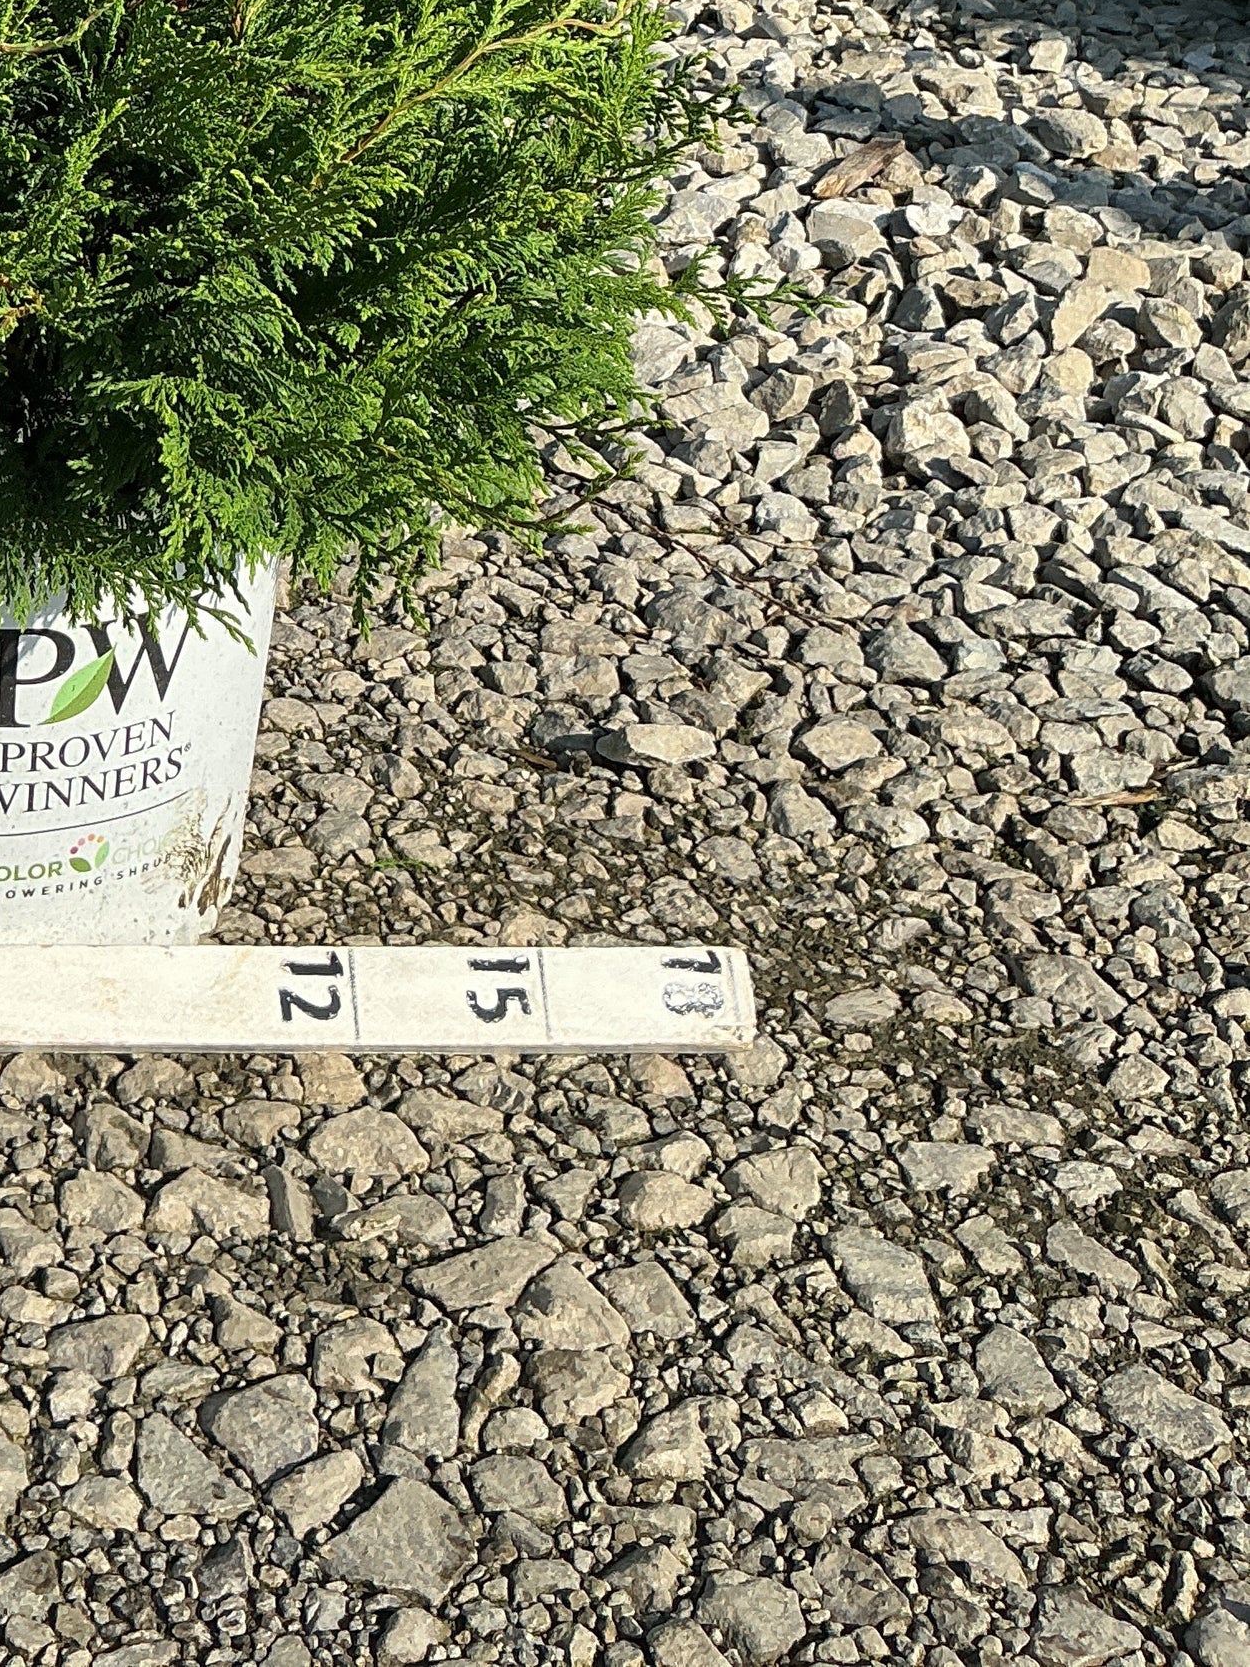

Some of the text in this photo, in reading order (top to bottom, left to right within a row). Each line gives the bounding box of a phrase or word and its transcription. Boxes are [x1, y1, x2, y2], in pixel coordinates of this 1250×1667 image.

[116, 850, 172, 880] SHRUB
[279, 951, 344, 1022] 12
[466, 956, 532, 1024] 15
[661, 950, 725, 1019] 18
